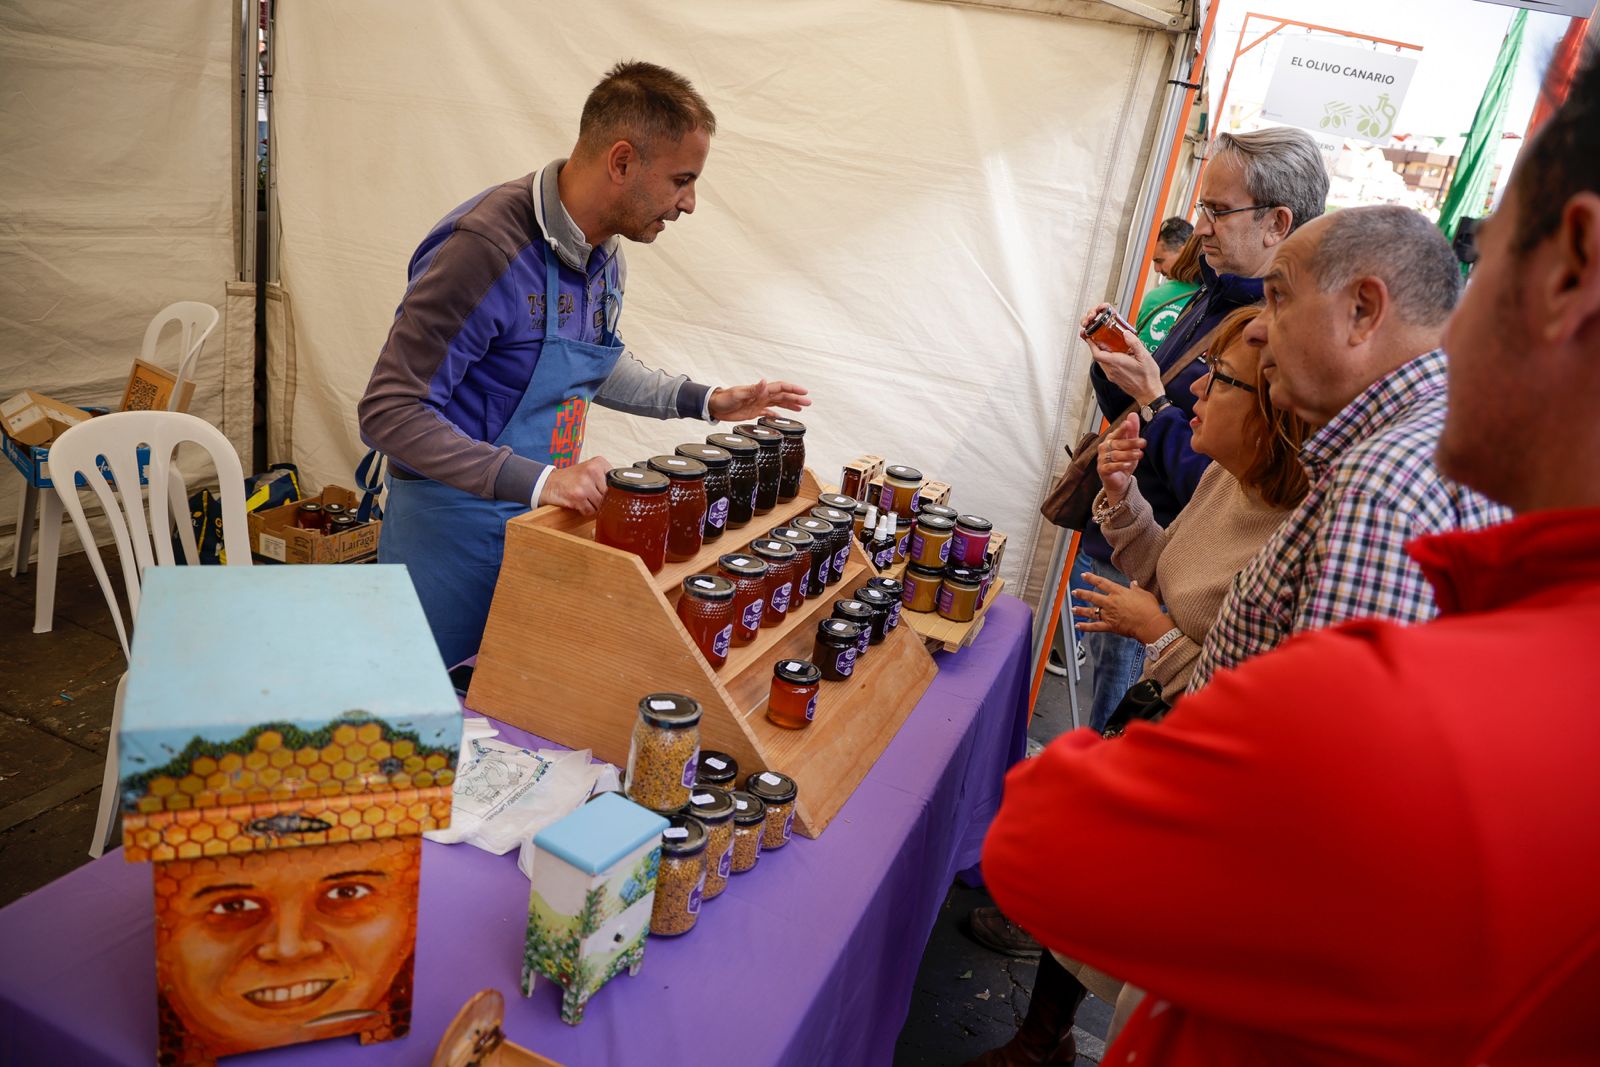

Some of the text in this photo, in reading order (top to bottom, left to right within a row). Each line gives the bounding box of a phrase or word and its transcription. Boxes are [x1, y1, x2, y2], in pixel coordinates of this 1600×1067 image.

[1291, 57, 1395, 85] EL OLIVO CANARIO
